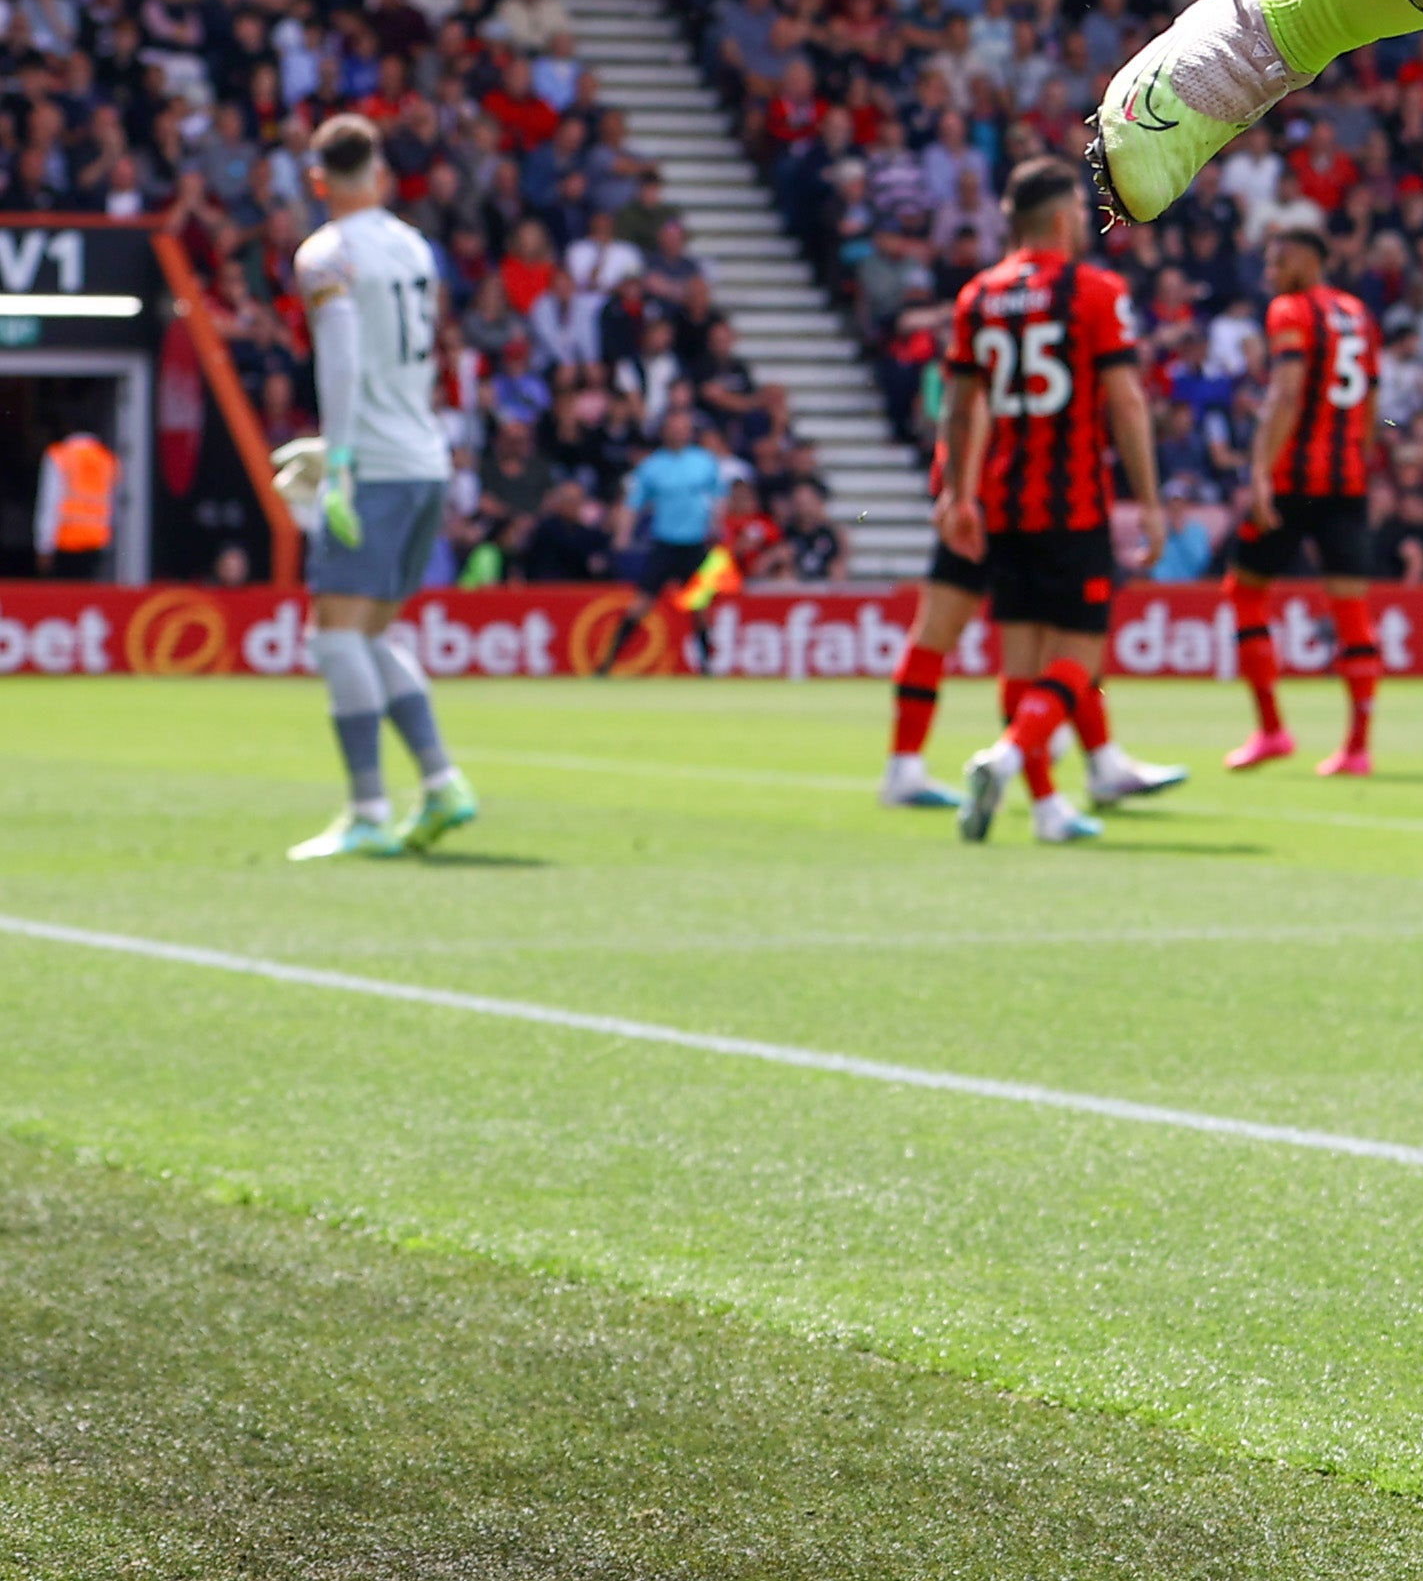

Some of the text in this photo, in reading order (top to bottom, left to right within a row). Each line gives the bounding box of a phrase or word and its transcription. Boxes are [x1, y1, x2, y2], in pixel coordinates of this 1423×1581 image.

[973, 321, 1074, 418] 25
[1327, 335, 1370, 409] 5
[682, 602, 989, 682] dafabt
